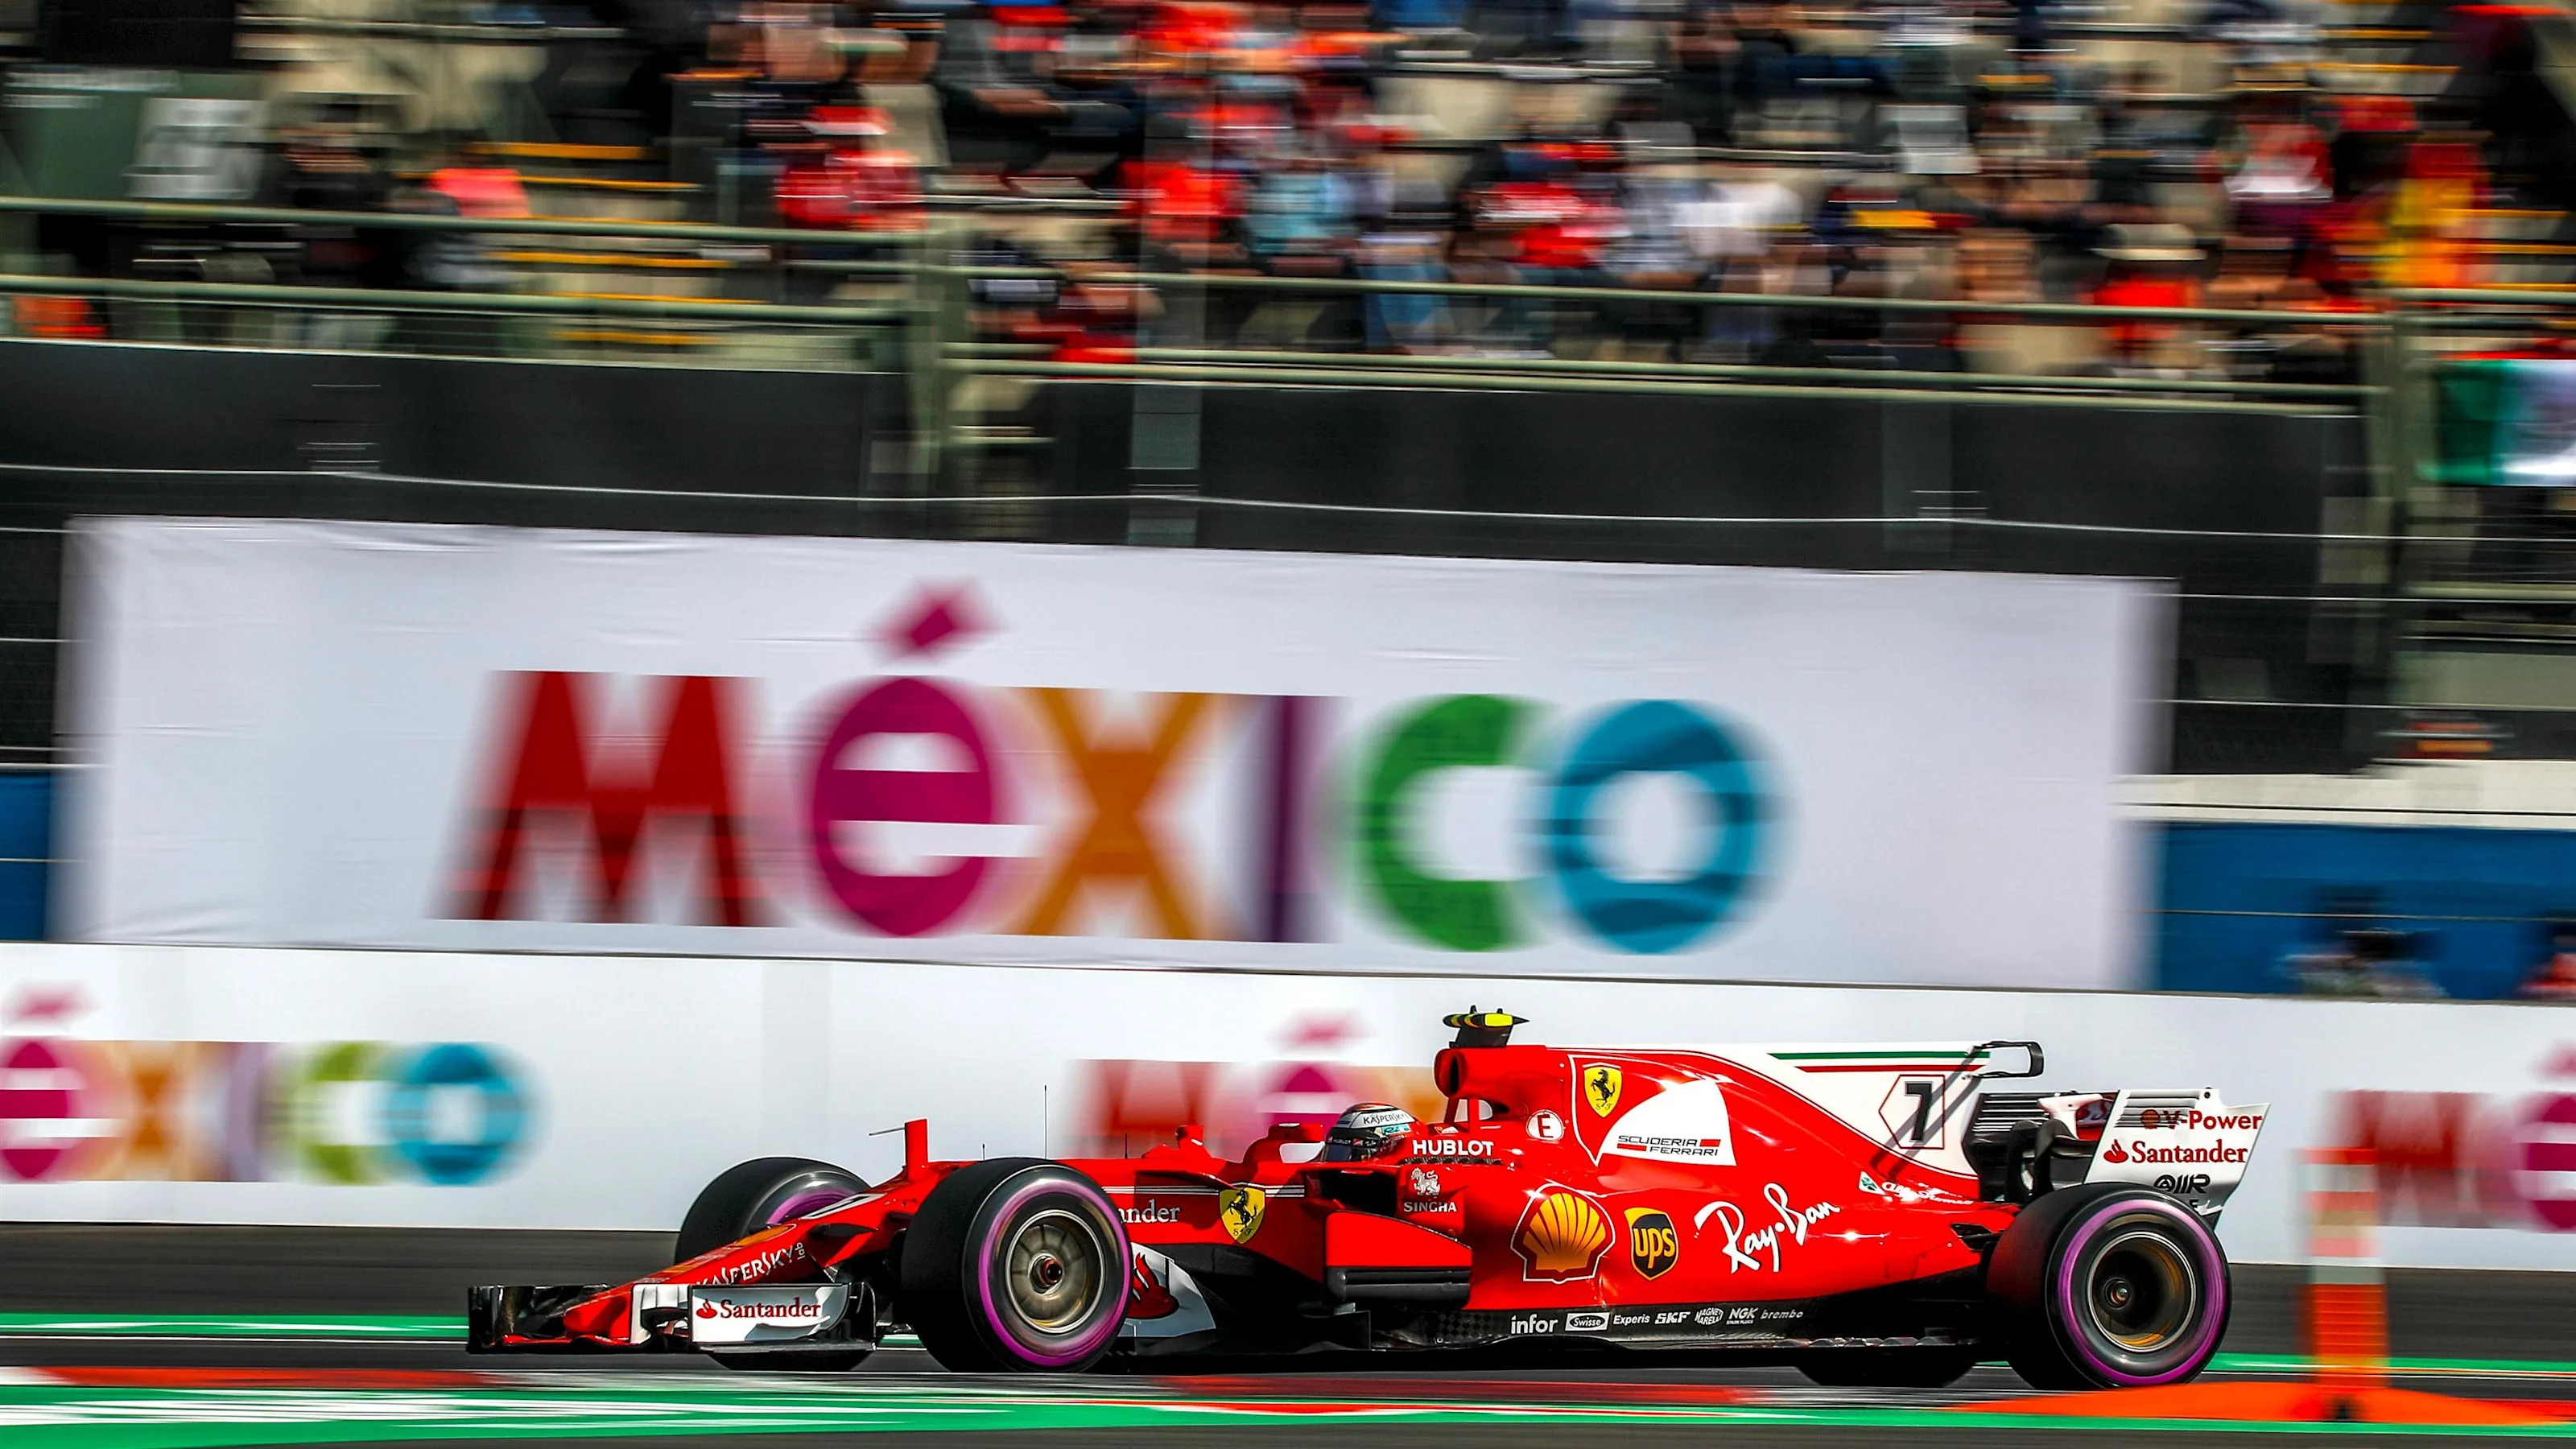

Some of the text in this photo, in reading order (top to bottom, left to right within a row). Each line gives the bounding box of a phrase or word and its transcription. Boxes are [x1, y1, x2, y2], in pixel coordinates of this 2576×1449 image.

[1905, 1081, 1933, 1142] 7
[2163, 1110, 2263, 1129] V-Power
[1537, 1114, 1554, 1138] E
[1412, 1139, 1495, 1156] HUBLOT
[1618, 1135, 1698, 1147] SCUDERIA
[1649, 1146, 1719, 1156] FERRARI
[2132, 1139, 2248, 1163] Santander
[1117, 1199, 1181, 1224] ander
[1403, 1201, 1457, 1212] SINGHA
[1634, 1228, 1676, 1269] ups
[720, 1297, 821, 1319] Santander
[1728, 1307, 1759, 1320] NGK
[1761, 1309, 1804, 1319] brembo
[1511, 1314, 1558, 1334] infor
[1573, 1317, 1602, 1327] Swisse
[1612, 1314, 1650, 1327] Experis
[1655, 1311, 1691, 1324] SKF
